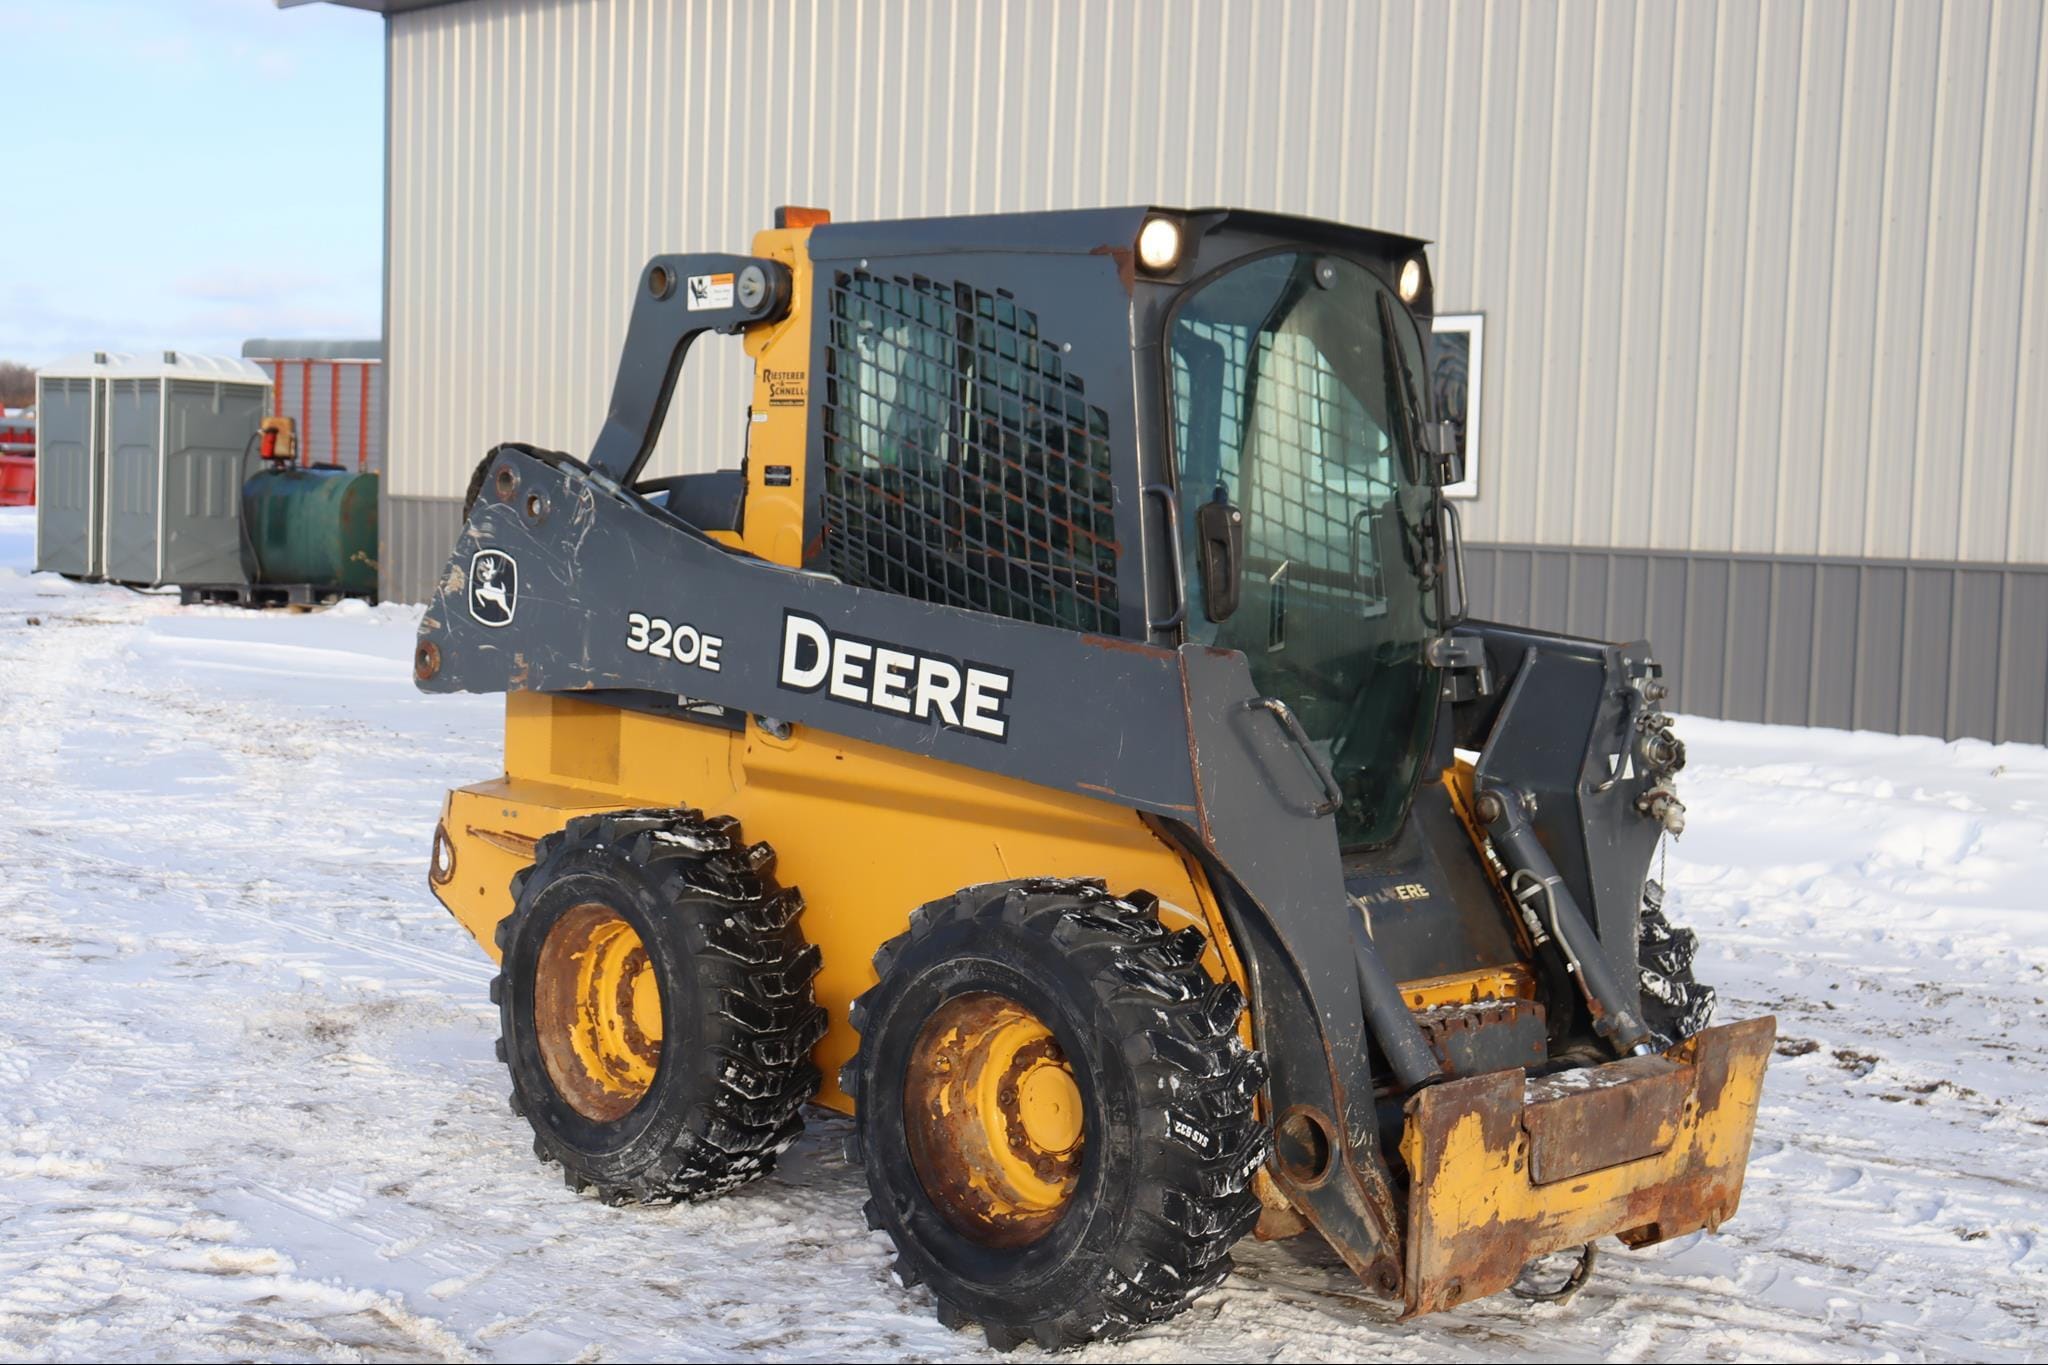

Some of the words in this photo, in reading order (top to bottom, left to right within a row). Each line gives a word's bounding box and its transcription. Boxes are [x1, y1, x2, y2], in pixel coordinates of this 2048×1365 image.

[763, 369, 805, 383] RIESTERER
[769, 383, 805, 397] SCHNELL
[626, 612, 723, 672] 320E
[781, 614, 1009, 737] DEERE
